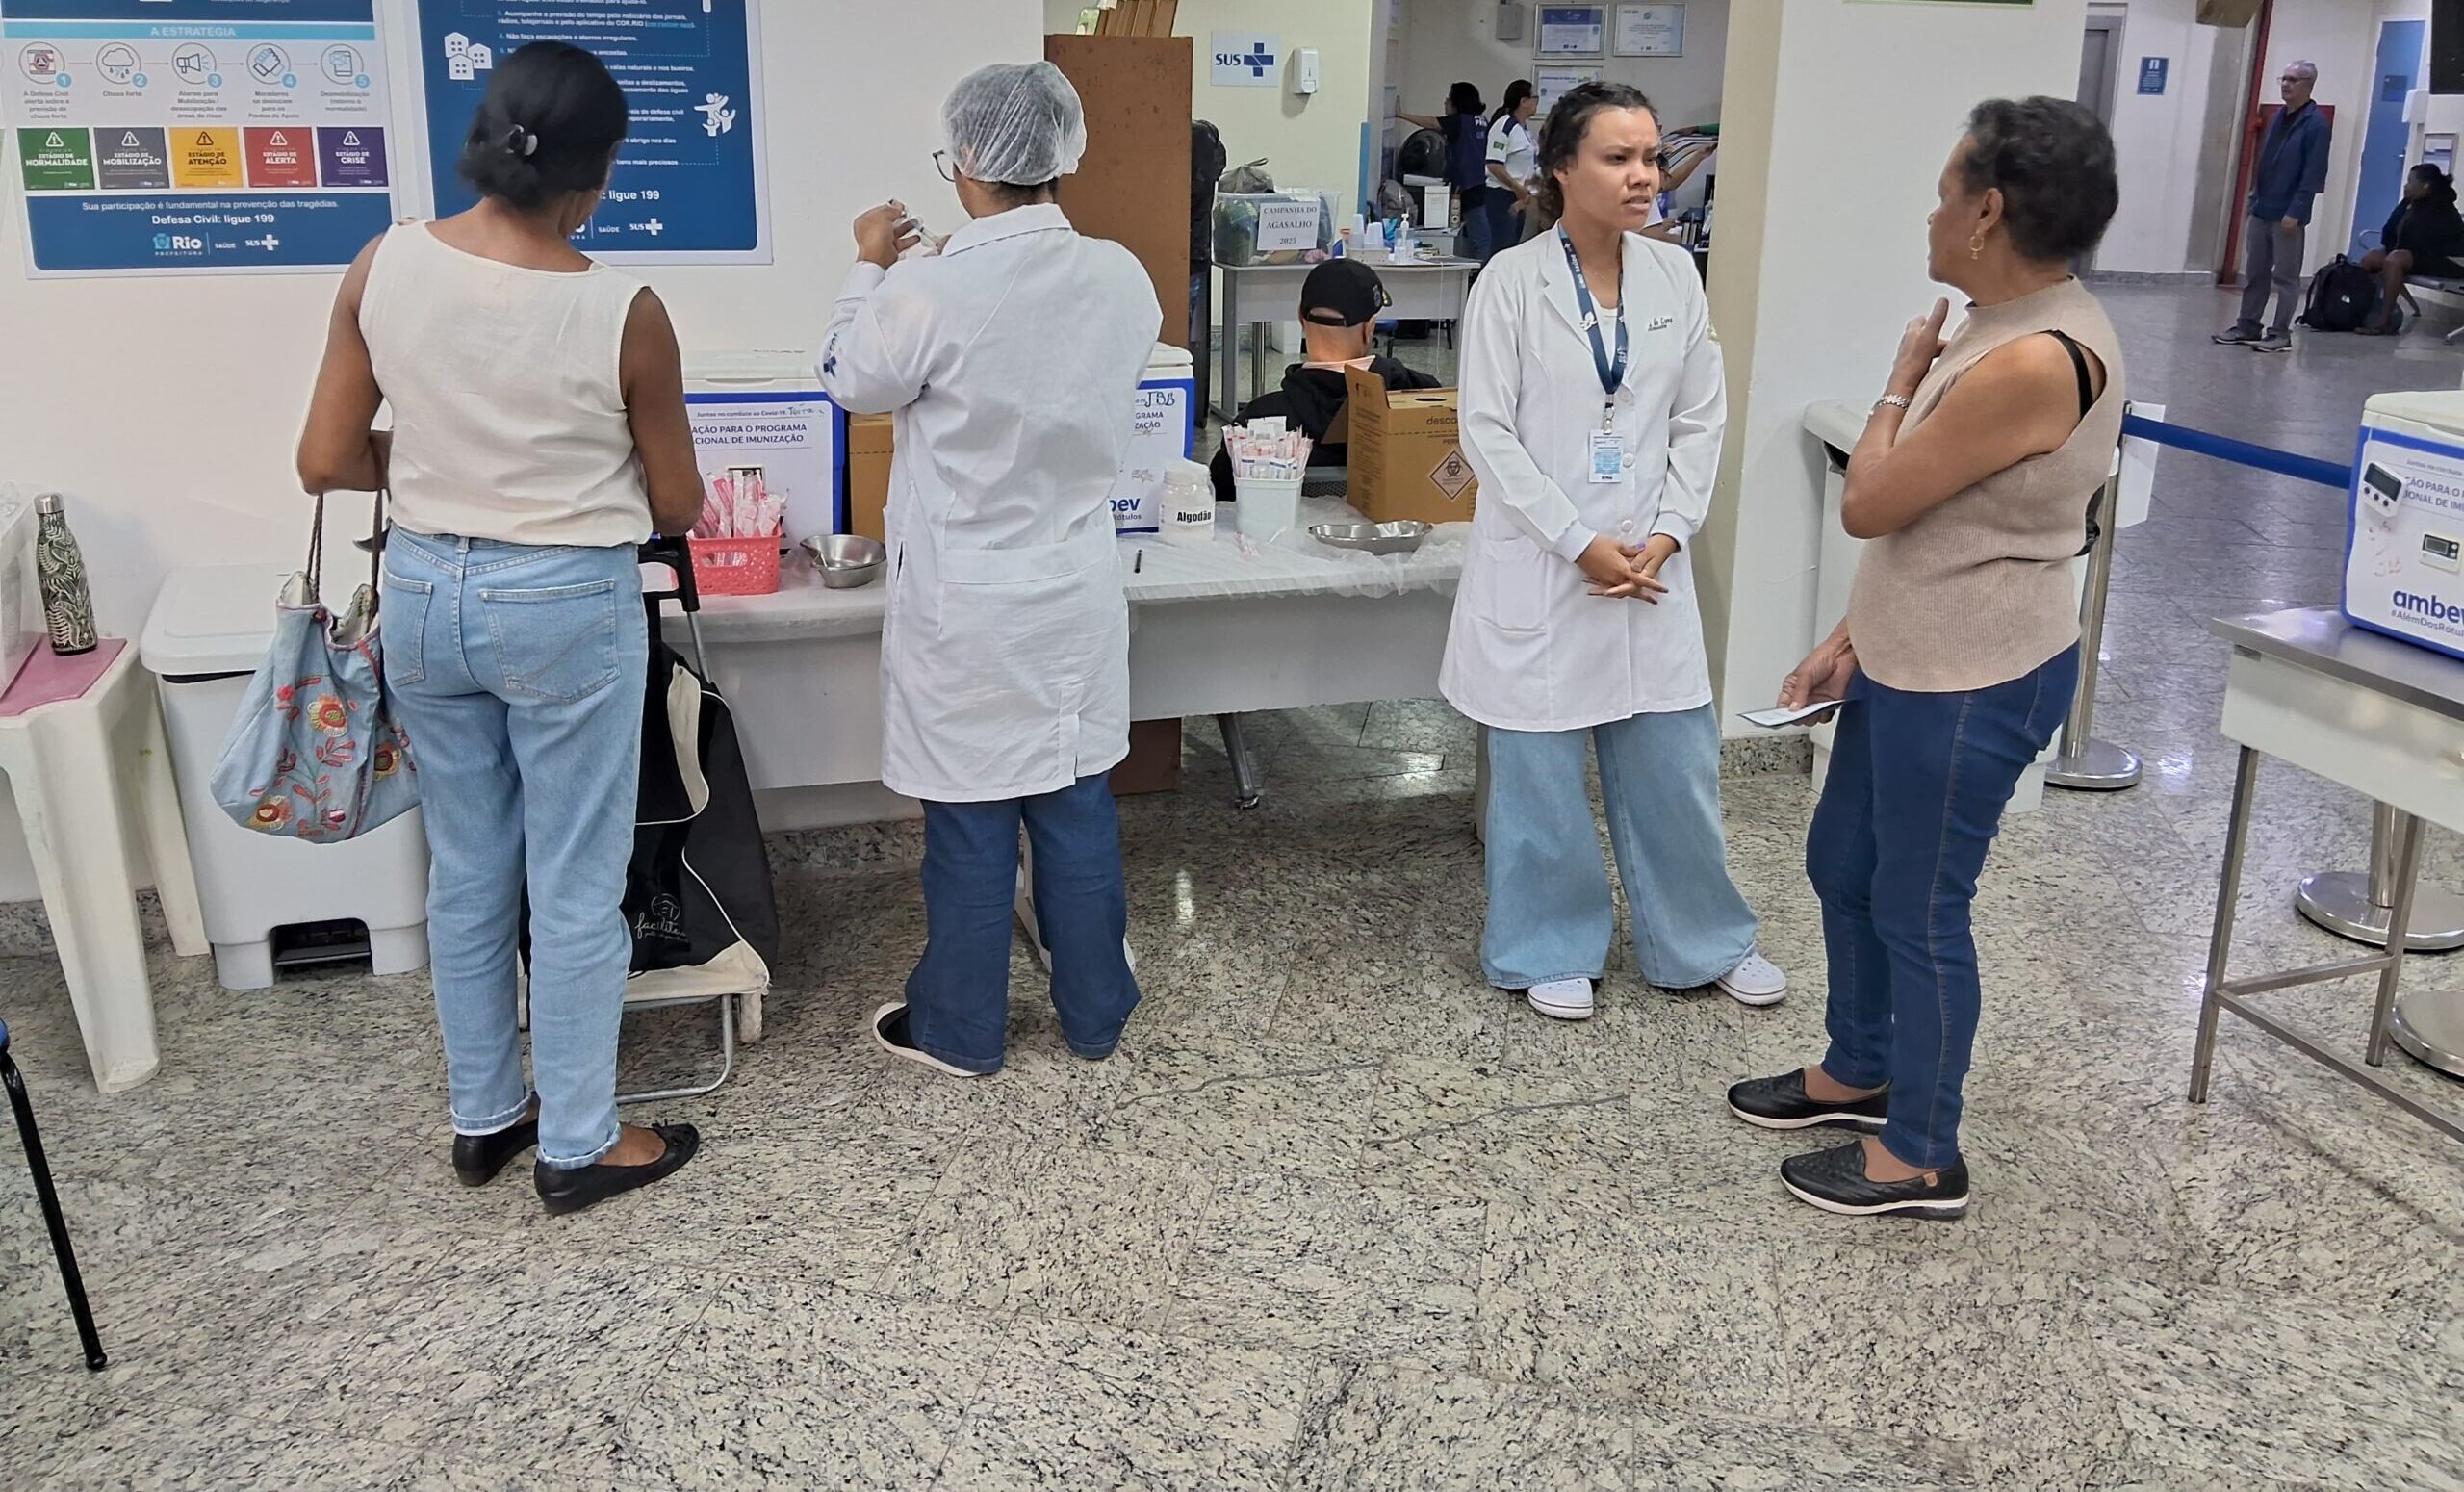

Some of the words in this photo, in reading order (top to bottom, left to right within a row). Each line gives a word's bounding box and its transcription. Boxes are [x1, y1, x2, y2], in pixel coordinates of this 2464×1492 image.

[150, 27, 161, 37] A
[1215, 53, 1242, 66] SUS
[25, 158, 88, 167] NORMALIDADE
[102, 155, 162, 166] MOBILIZAÇÃO
[188, 156, 227, 166] ATENÇÃO
[265, 156, 297, 165] ALERTA
[341, 156, 366, 165] CRISE
[608, 190, 637, 202] ligue
[640, 190, 660, 200] 199
[82, 202, 99, 211] Sua
[101, 201, 156, 212] participação
[165, 200, 218, 210] fundamental
[232, 199, 278, 210] prevenção
[151, 215, 192, 224] Defesa
[193, 214, 221, 224] Civil:
[224, 214, 252, 225] ligue
[254, 214, 274, 223] 199
[1266, 220, 1313, 229] AGASALHO
[172, 235, 202, 249] Rio
[1136, 411, 1164, 420] GRAMA
[745, 424, 754, 433] O
[755, 424, 808, 432] PROGRAMA
[1135, 421, 1161, 429] ZAÇÃO
[746, 434, 805, 445] IMUNIZAÇÃO
[2426, 480, 2451, 495] PARA
[2451, 487, 2461, 498] O
[2435, 497, 2448, 508] DE
[1176, 510, 1212, 523] Algodão
